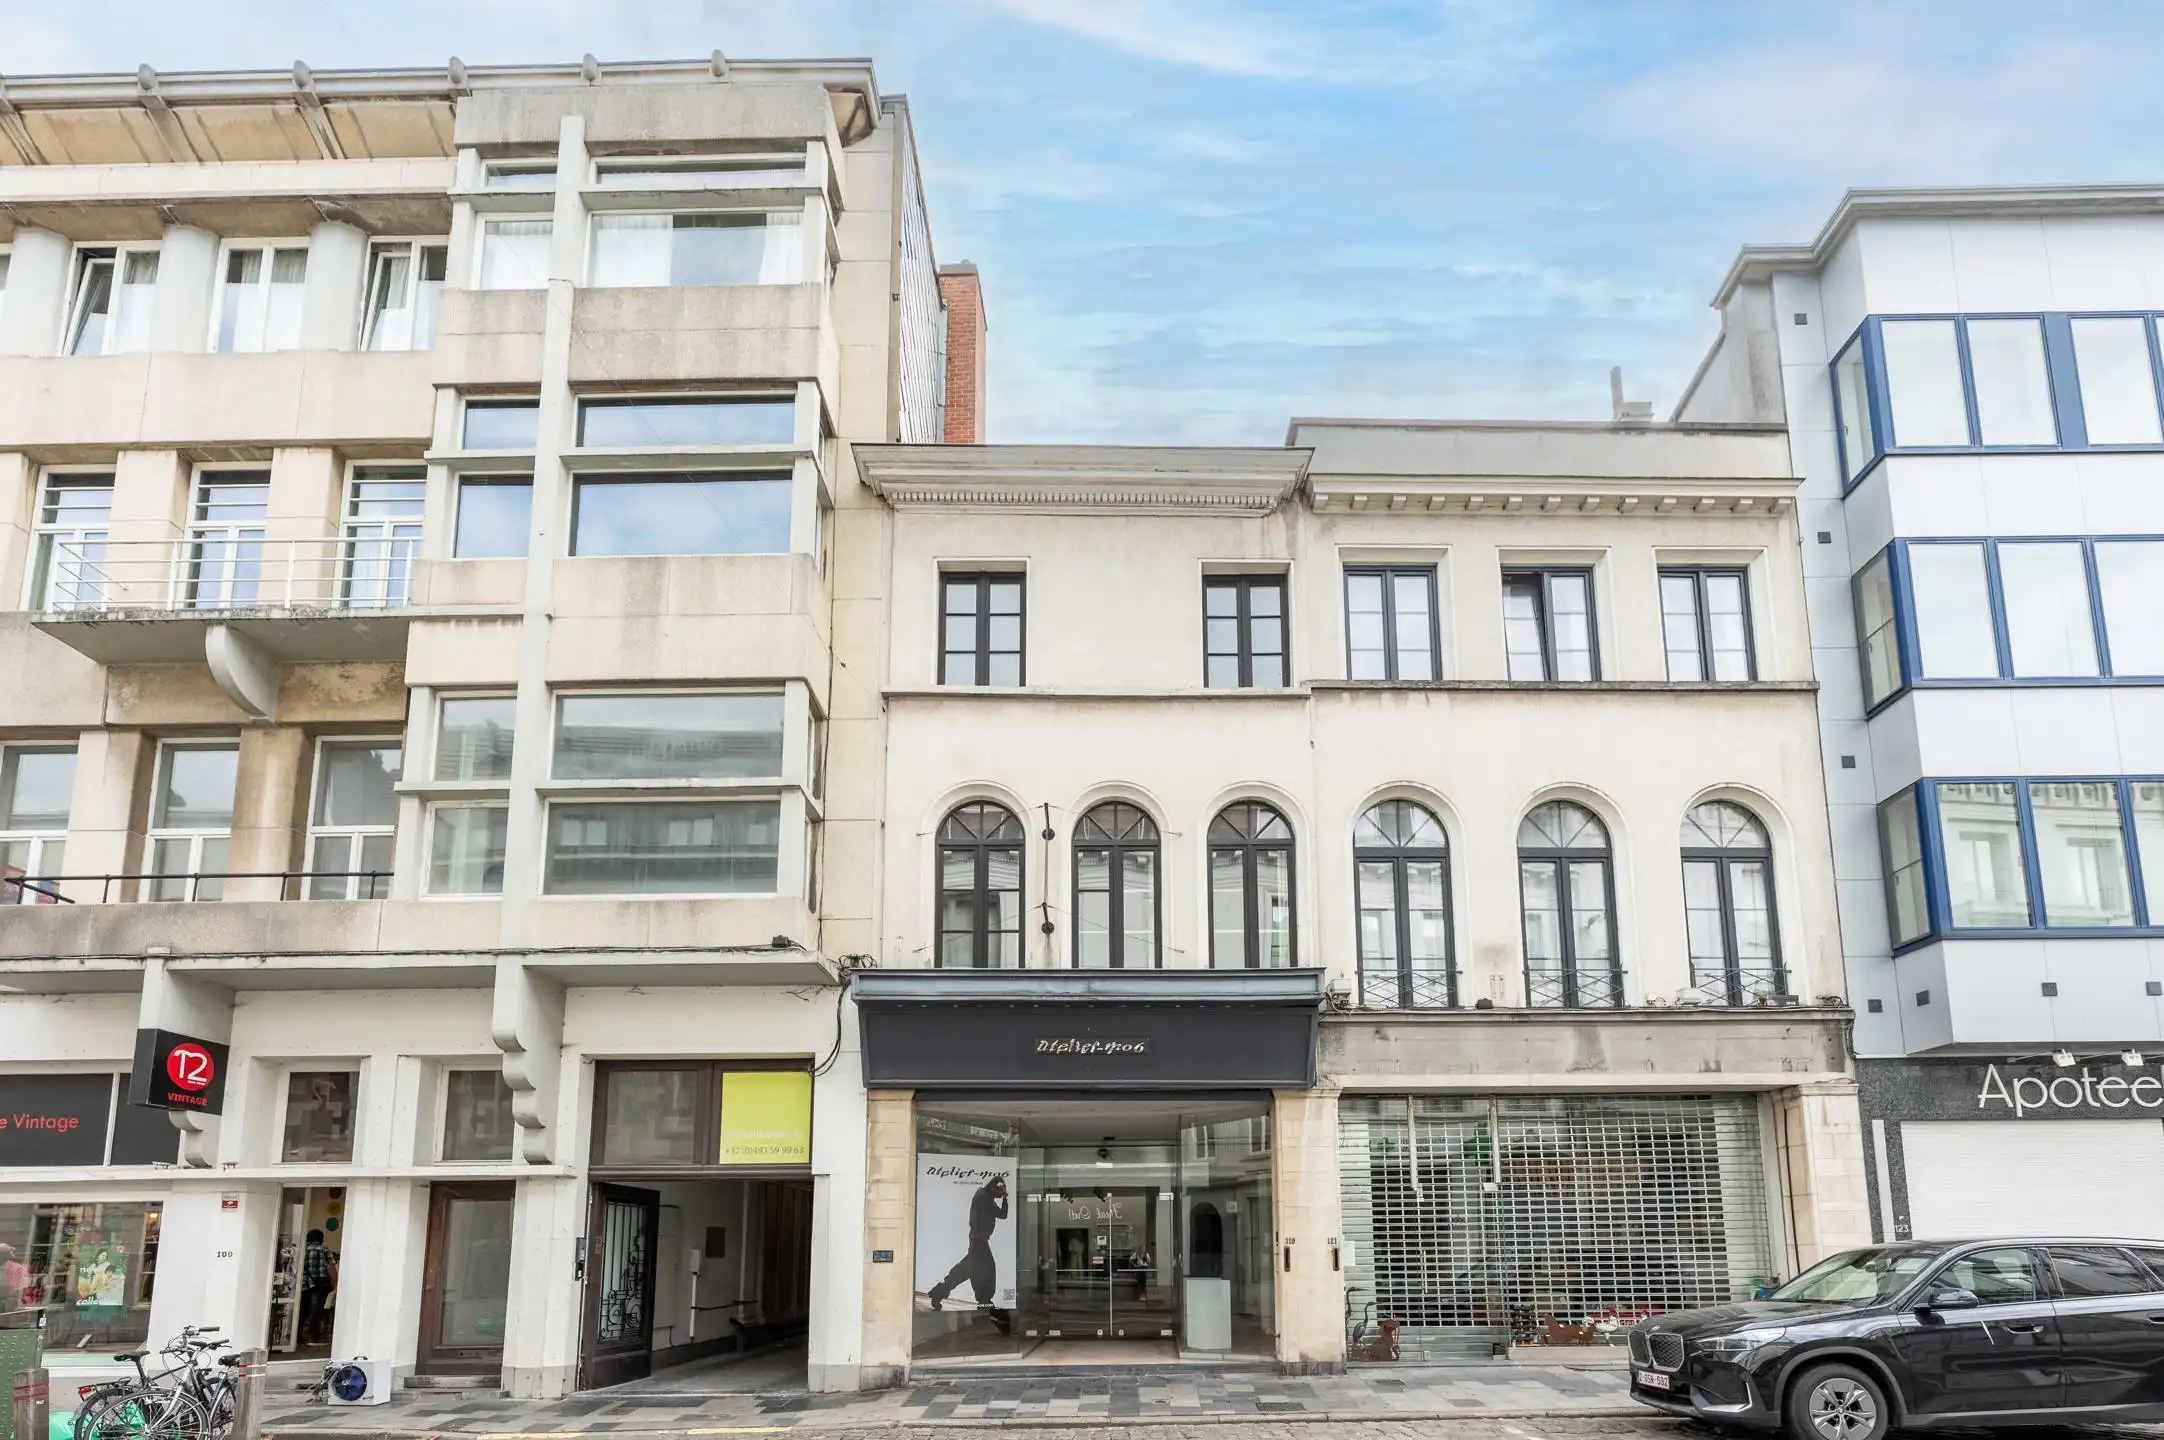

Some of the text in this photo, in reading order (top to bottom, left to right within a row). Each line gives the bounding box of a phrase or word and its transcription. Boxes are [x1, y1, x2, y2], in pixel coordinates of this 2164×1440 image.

[167, 1092, 208, 1106] VINTAGE
[1977, 1063, 2164, 1118] Apotee
[12, 1113, 79, 1133] Vintage
